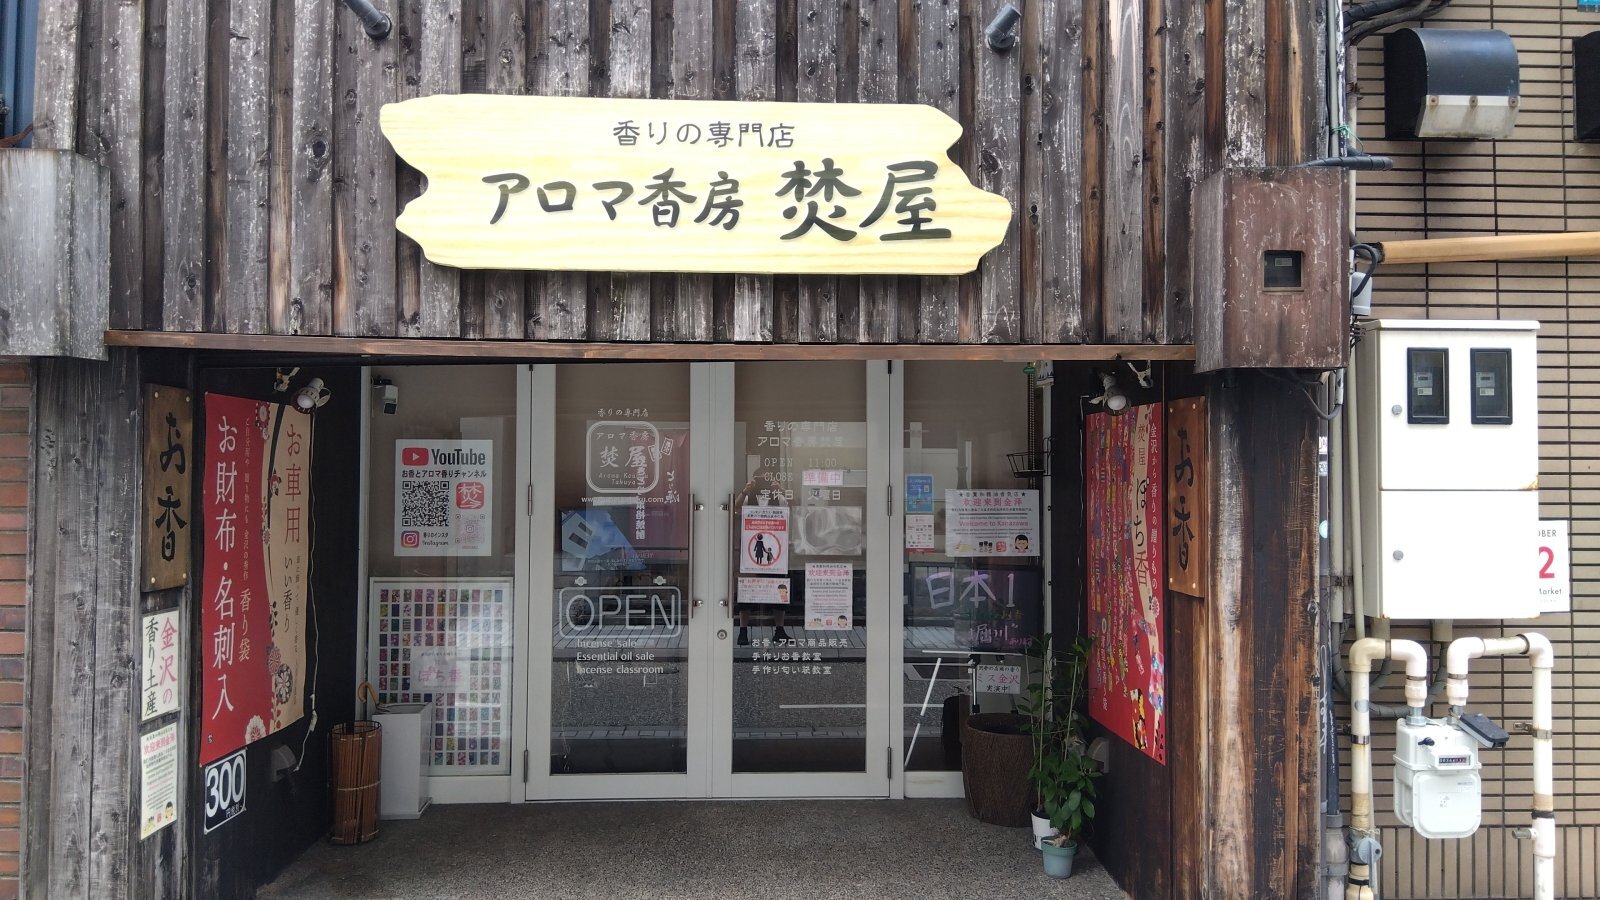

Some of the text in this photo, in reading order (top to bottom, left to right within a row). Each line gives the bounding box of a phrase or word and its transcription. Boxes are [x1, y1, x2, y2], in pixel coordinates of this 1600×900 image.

[613, 120, 795, 148] 香りの専門店
[481, 157, 952, 241] アロマ香房 焚屋
[598, 408, 649, 417] 香りの専門店
[596, 431, 650, 440] アロマ香房
[432, 449, 486, 465] YouTube
[764, 458, 793, 467] OPEN
[402, 470, 487, 478] お香とアロマ香りチャンネル
[764, 472, 793, 481] CLOSE
[155, 412, 187, 561] お香
[285, 424, 302, 544] お車用
[760, 489, 794, 500] 定休日
[1172, 425, 1195, 571] お香
[212, 416, 238, 720] お財布・名刺入
[566, 595, 675, 631] OPEN
[577, 639, 612, 648] Incense
[752, 639, 848, 647] お香・アロマ商品販売
[160, 617, 177, 704] 金沢の
[576, 652, 655, 661] Essential oil sale
[752, 652, 822, 661] 手作りお香教室
[144, 617, 158, 716] 香り土産
[617, 665, 664, 674] classroom
[206, 755, 245, 818] 300
